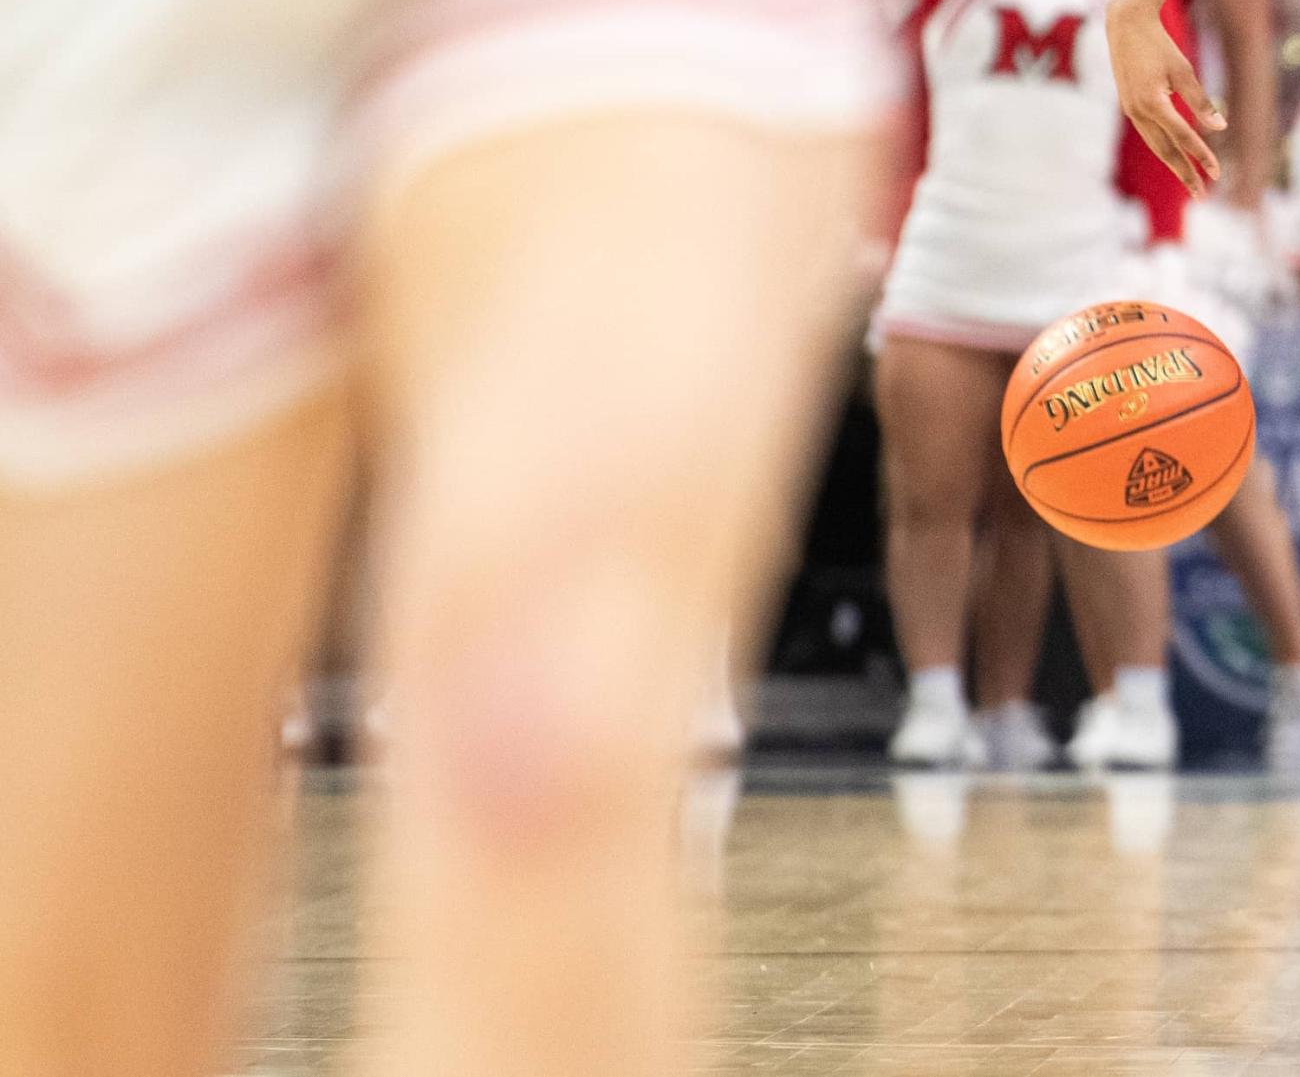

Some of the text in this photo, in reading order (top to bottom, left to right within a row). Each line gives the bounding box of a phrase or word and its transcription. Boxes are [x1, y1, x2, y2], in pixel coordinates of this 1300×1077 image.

[988, 7, 1086, 83] M
[1042, 347, 1203, 432] SPALDING
[1127, 465, 1184, 495] MAC
